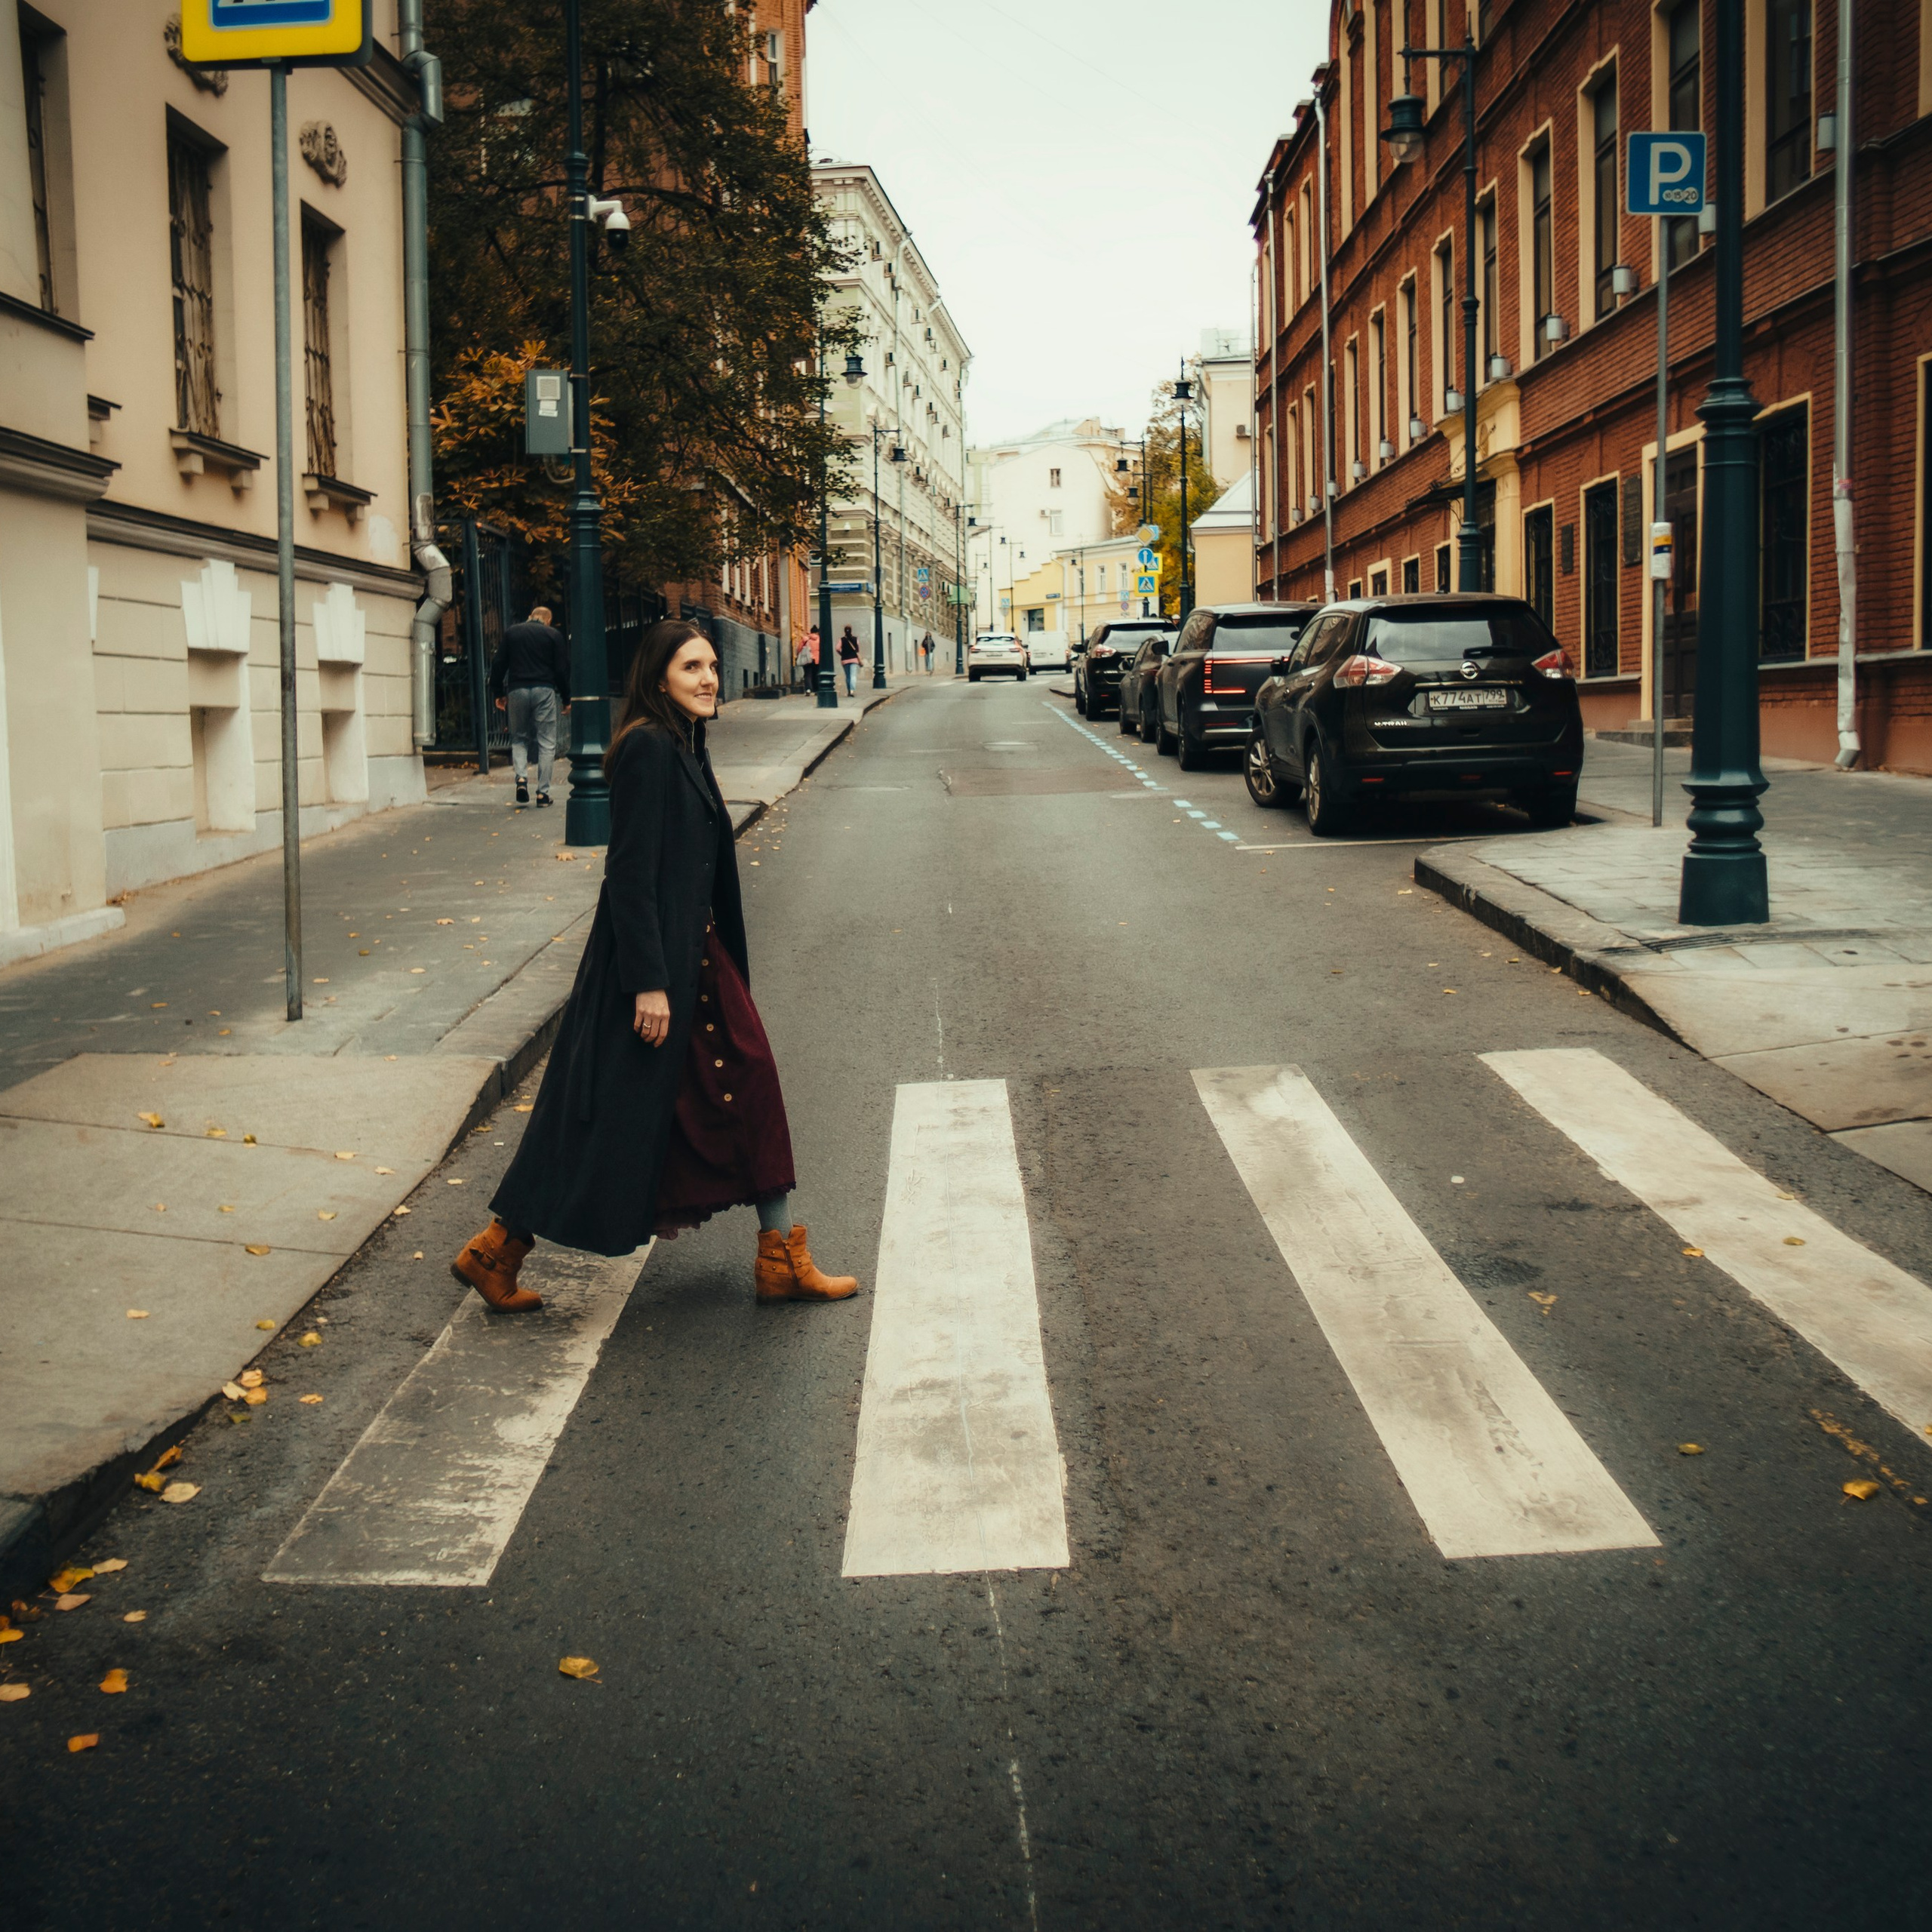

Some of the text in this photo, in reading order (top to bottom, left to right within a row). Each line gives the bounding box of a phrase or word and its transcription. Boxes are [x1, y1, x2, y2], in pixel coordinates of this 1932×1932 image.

[1649, 142, 1692, 205] P
[1684, 190, 1697, 200] 20
[1484, 689, 1503, 700] 799
